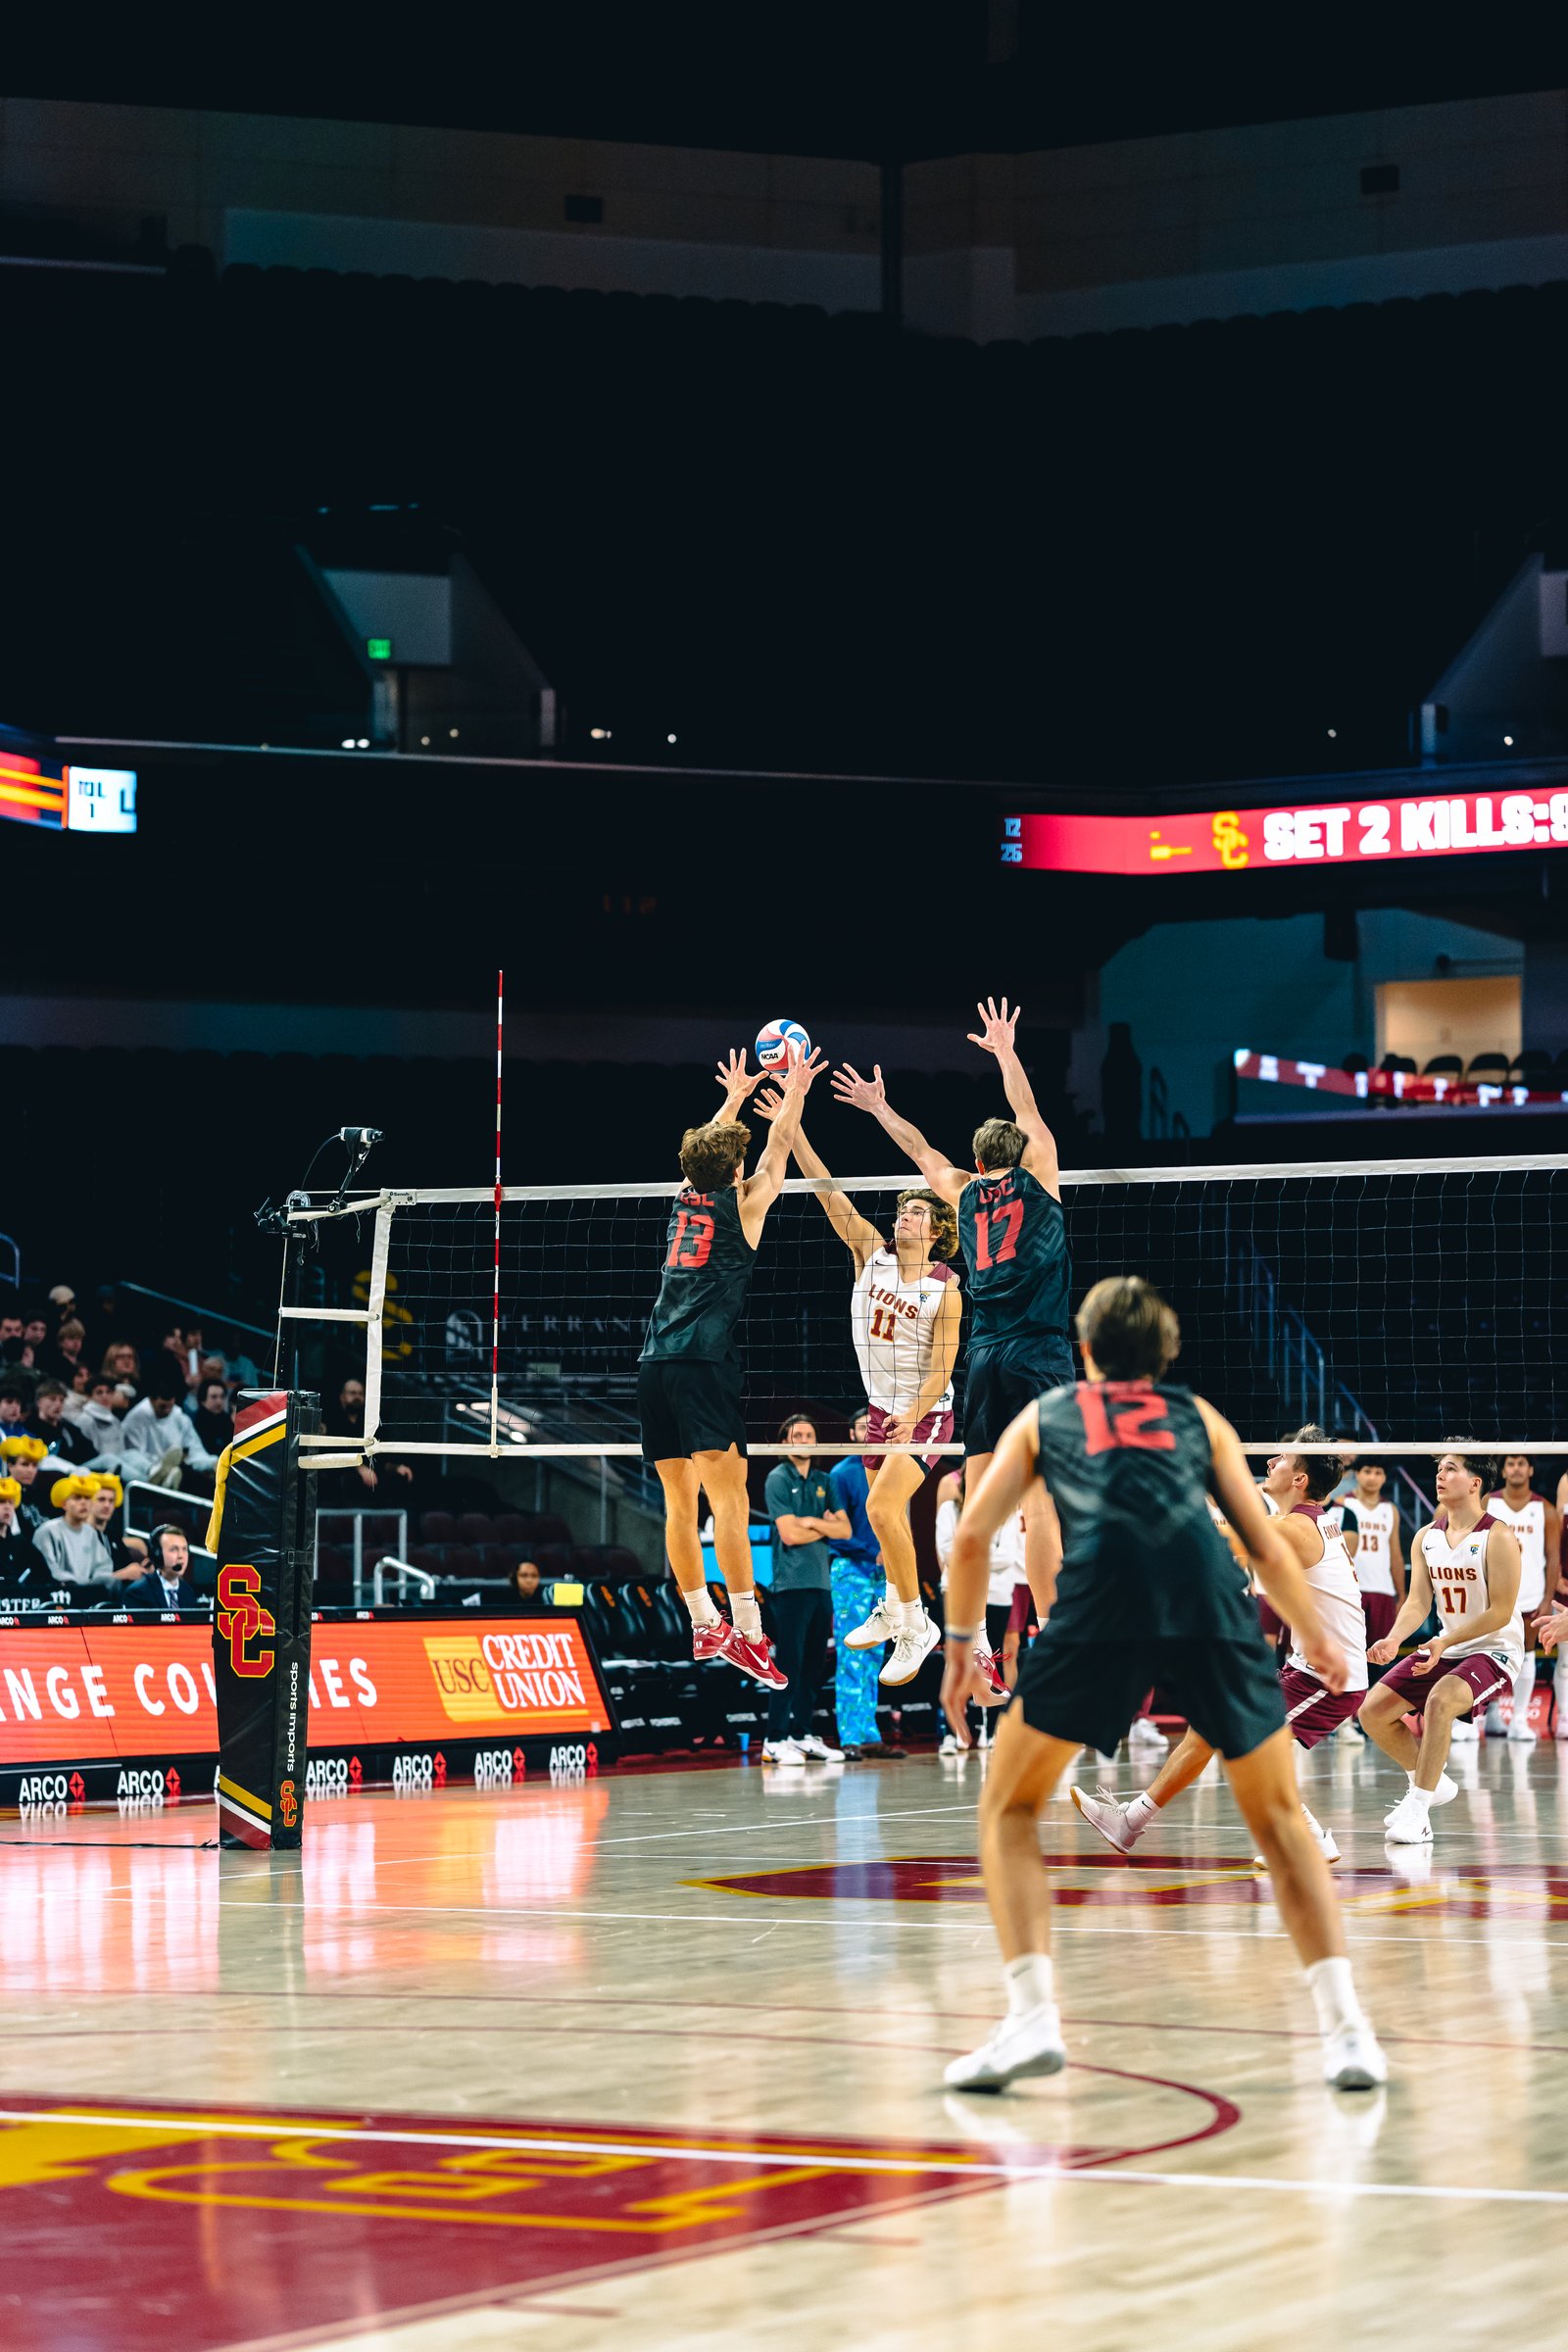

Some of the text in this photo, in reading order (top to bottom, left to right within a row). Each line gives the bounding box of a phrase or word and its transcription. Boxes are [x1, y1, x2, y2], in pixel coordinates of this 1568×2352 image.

[1263, 807, 1350, 860] SET
[1358, 805, 1391, 855] 2
[666, 1211, 715, 1268] 13
[974, 1199, 1025, 1271] 17
[868, 1284, 919, 1319] LIONS
[870, 1308, 897, 1343] 11
[1076, 1389, 1176, 1456] 12
[1360, 1521, 1387, 1532] IONS
[1361, 1535, 1379, 1552] 13
[1430, 1566, 1477, 1581] LIONS
[1442, 1587, 1467, 1614] 17
[218, 1564, 275, 1678] SC
[432, 1634, 576, 1694] USC CREDIT
[0, 1666, 115, 1722] NGE
[493, 1670, 586, 1709] UNION
[287, 1662, 298, 1773] sports imports
[306, 1758, 348, 1783] ARCO
[393, 1754, 433, 1778] ARCO
[474, 1749, 513, 1774] ARCO
[550, 1744, 586, 1768] ARCO
[20, 1775, 68, 1802] ARCO
[117, 1770, 165, 1795] ARCO
[280, 1780, 297, 1827] SC
